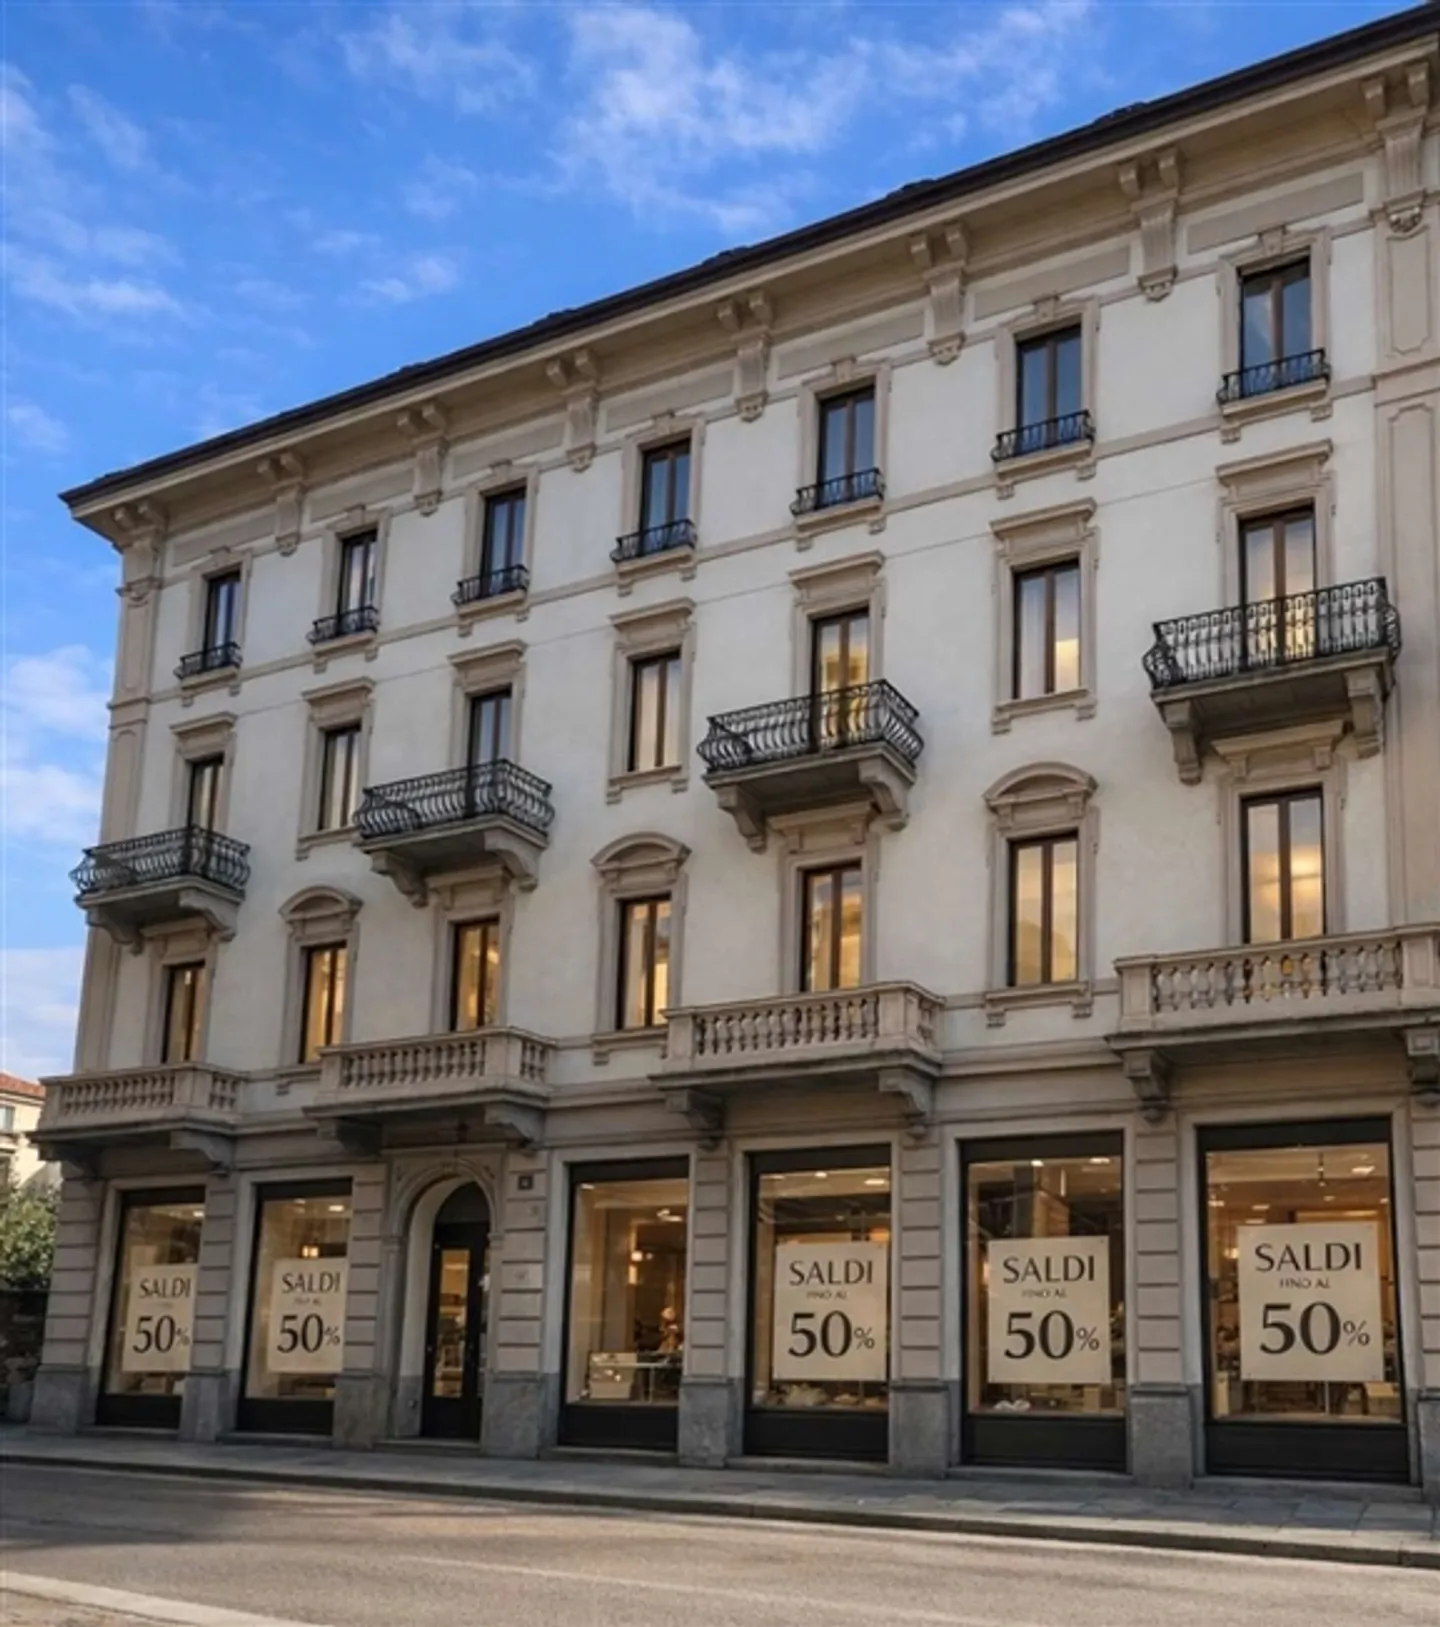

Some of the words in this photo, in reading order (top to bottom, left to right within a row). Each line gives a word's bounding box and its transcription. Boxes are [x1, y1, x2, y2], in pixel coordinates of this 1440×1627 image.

[789, 1260, 873, 1287] SALDI
[1002, 1255, 1095, 1284] SALDI
[1254, 1242, 1362, 1273] SALDI
[139, 1277, 191, 1299] SALDI
[282, 1271, 341, 1294] SALDI
[132, 1314, 191, 1354] 50%
[277, 1313, 341, 1354] 50%
[787, 1309, 876, 1359] 50%
[1003, 1309, 1100, 1361] 50%
[1259, 1301, 1371, 1356] 50%
